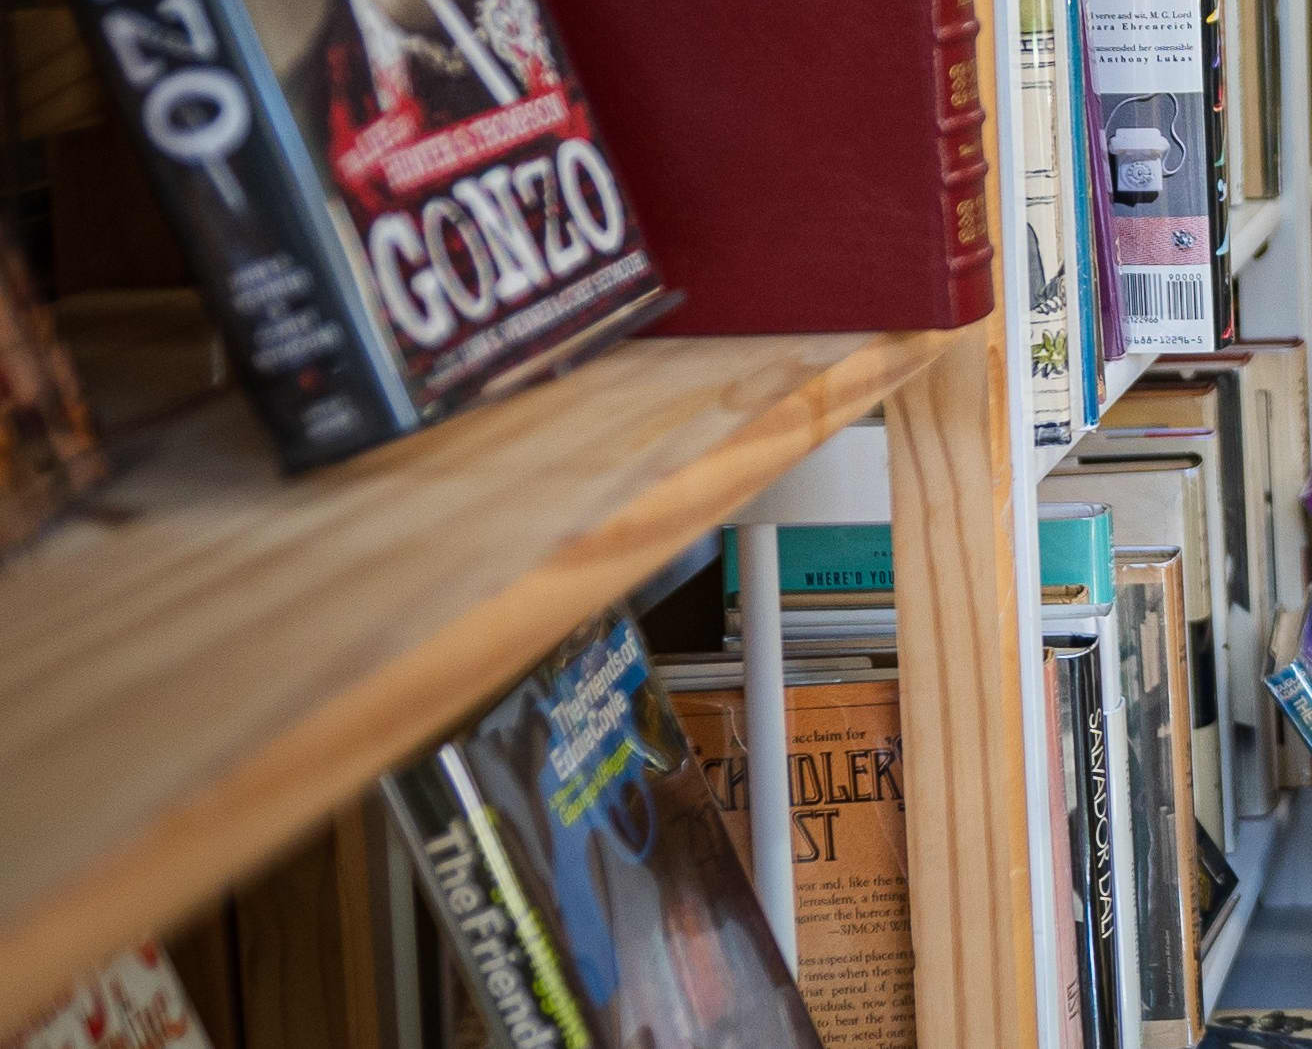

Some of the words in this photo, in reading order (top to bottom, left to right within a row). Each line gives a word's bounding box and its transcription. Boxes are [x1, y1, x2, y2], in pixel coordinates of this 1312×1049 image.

[1172, 11, 1192, 19] Lord
[1122, 22, 1192, 31] Ehrenreich
[1099, 55, 1149, 64] Anthony
[368, 137, 625, 347] GONZO
[1168, 273, 1202, 281] 90000
[805, 570, 863, 586] WHERE'D
[870, 569, 895, 584] YOU
[791, 730, 842, 745] acclaim
[846, 727, 866, 740] for
[1088, 708, 1110, 868] SALVADOR
[424, 819, 483, 915] The
[849, 877, 870, 888] like
[874, 874, 891, 886] the
[1098, 870, 1115, 938] DALI
[855, 907, 890, 919] horror
[865, 947, 895, 963] place
[865, 1013, 883, 1024] the
